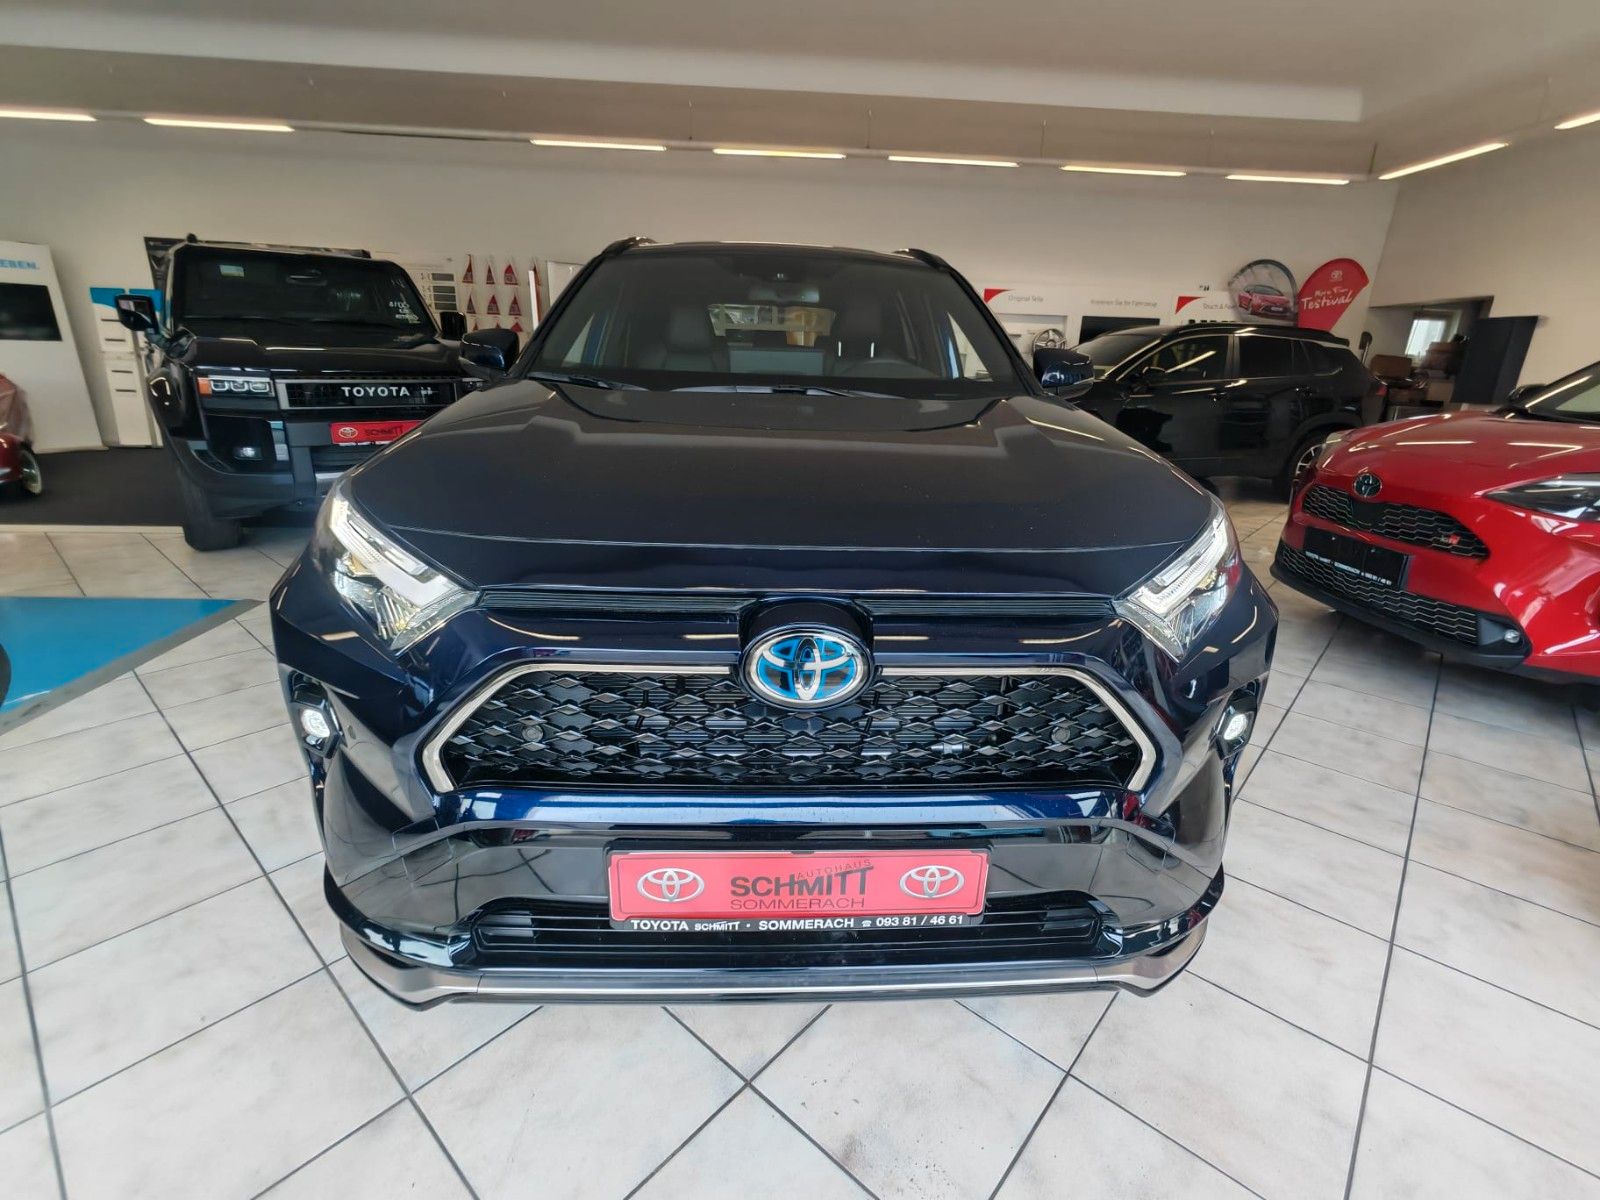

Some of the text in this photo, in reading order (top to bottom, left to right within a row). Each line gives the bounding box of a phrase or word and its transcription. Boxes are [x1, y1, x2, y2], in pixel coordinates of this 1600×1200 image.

[1301, 289, 1352, 310] Testival
[341, 386, 410, 397] TOYOTA
[797, 859, 872, 879] AUTOHAUS
[730, 865, 874, 897] SCHMITT
[730, 897, 865, 911] SOMMERACH
[631, 919, 689, 931] TOYOTA
[694, 920, 740, 932] SCHMITT
[758, 917, 854, 931] SOMMERACH
[876, 917, 899, 927] 093
[902, 917, 917, 927] 81
[929, 916, 947, 926] 46
[948, 915, 963, 925] 61
